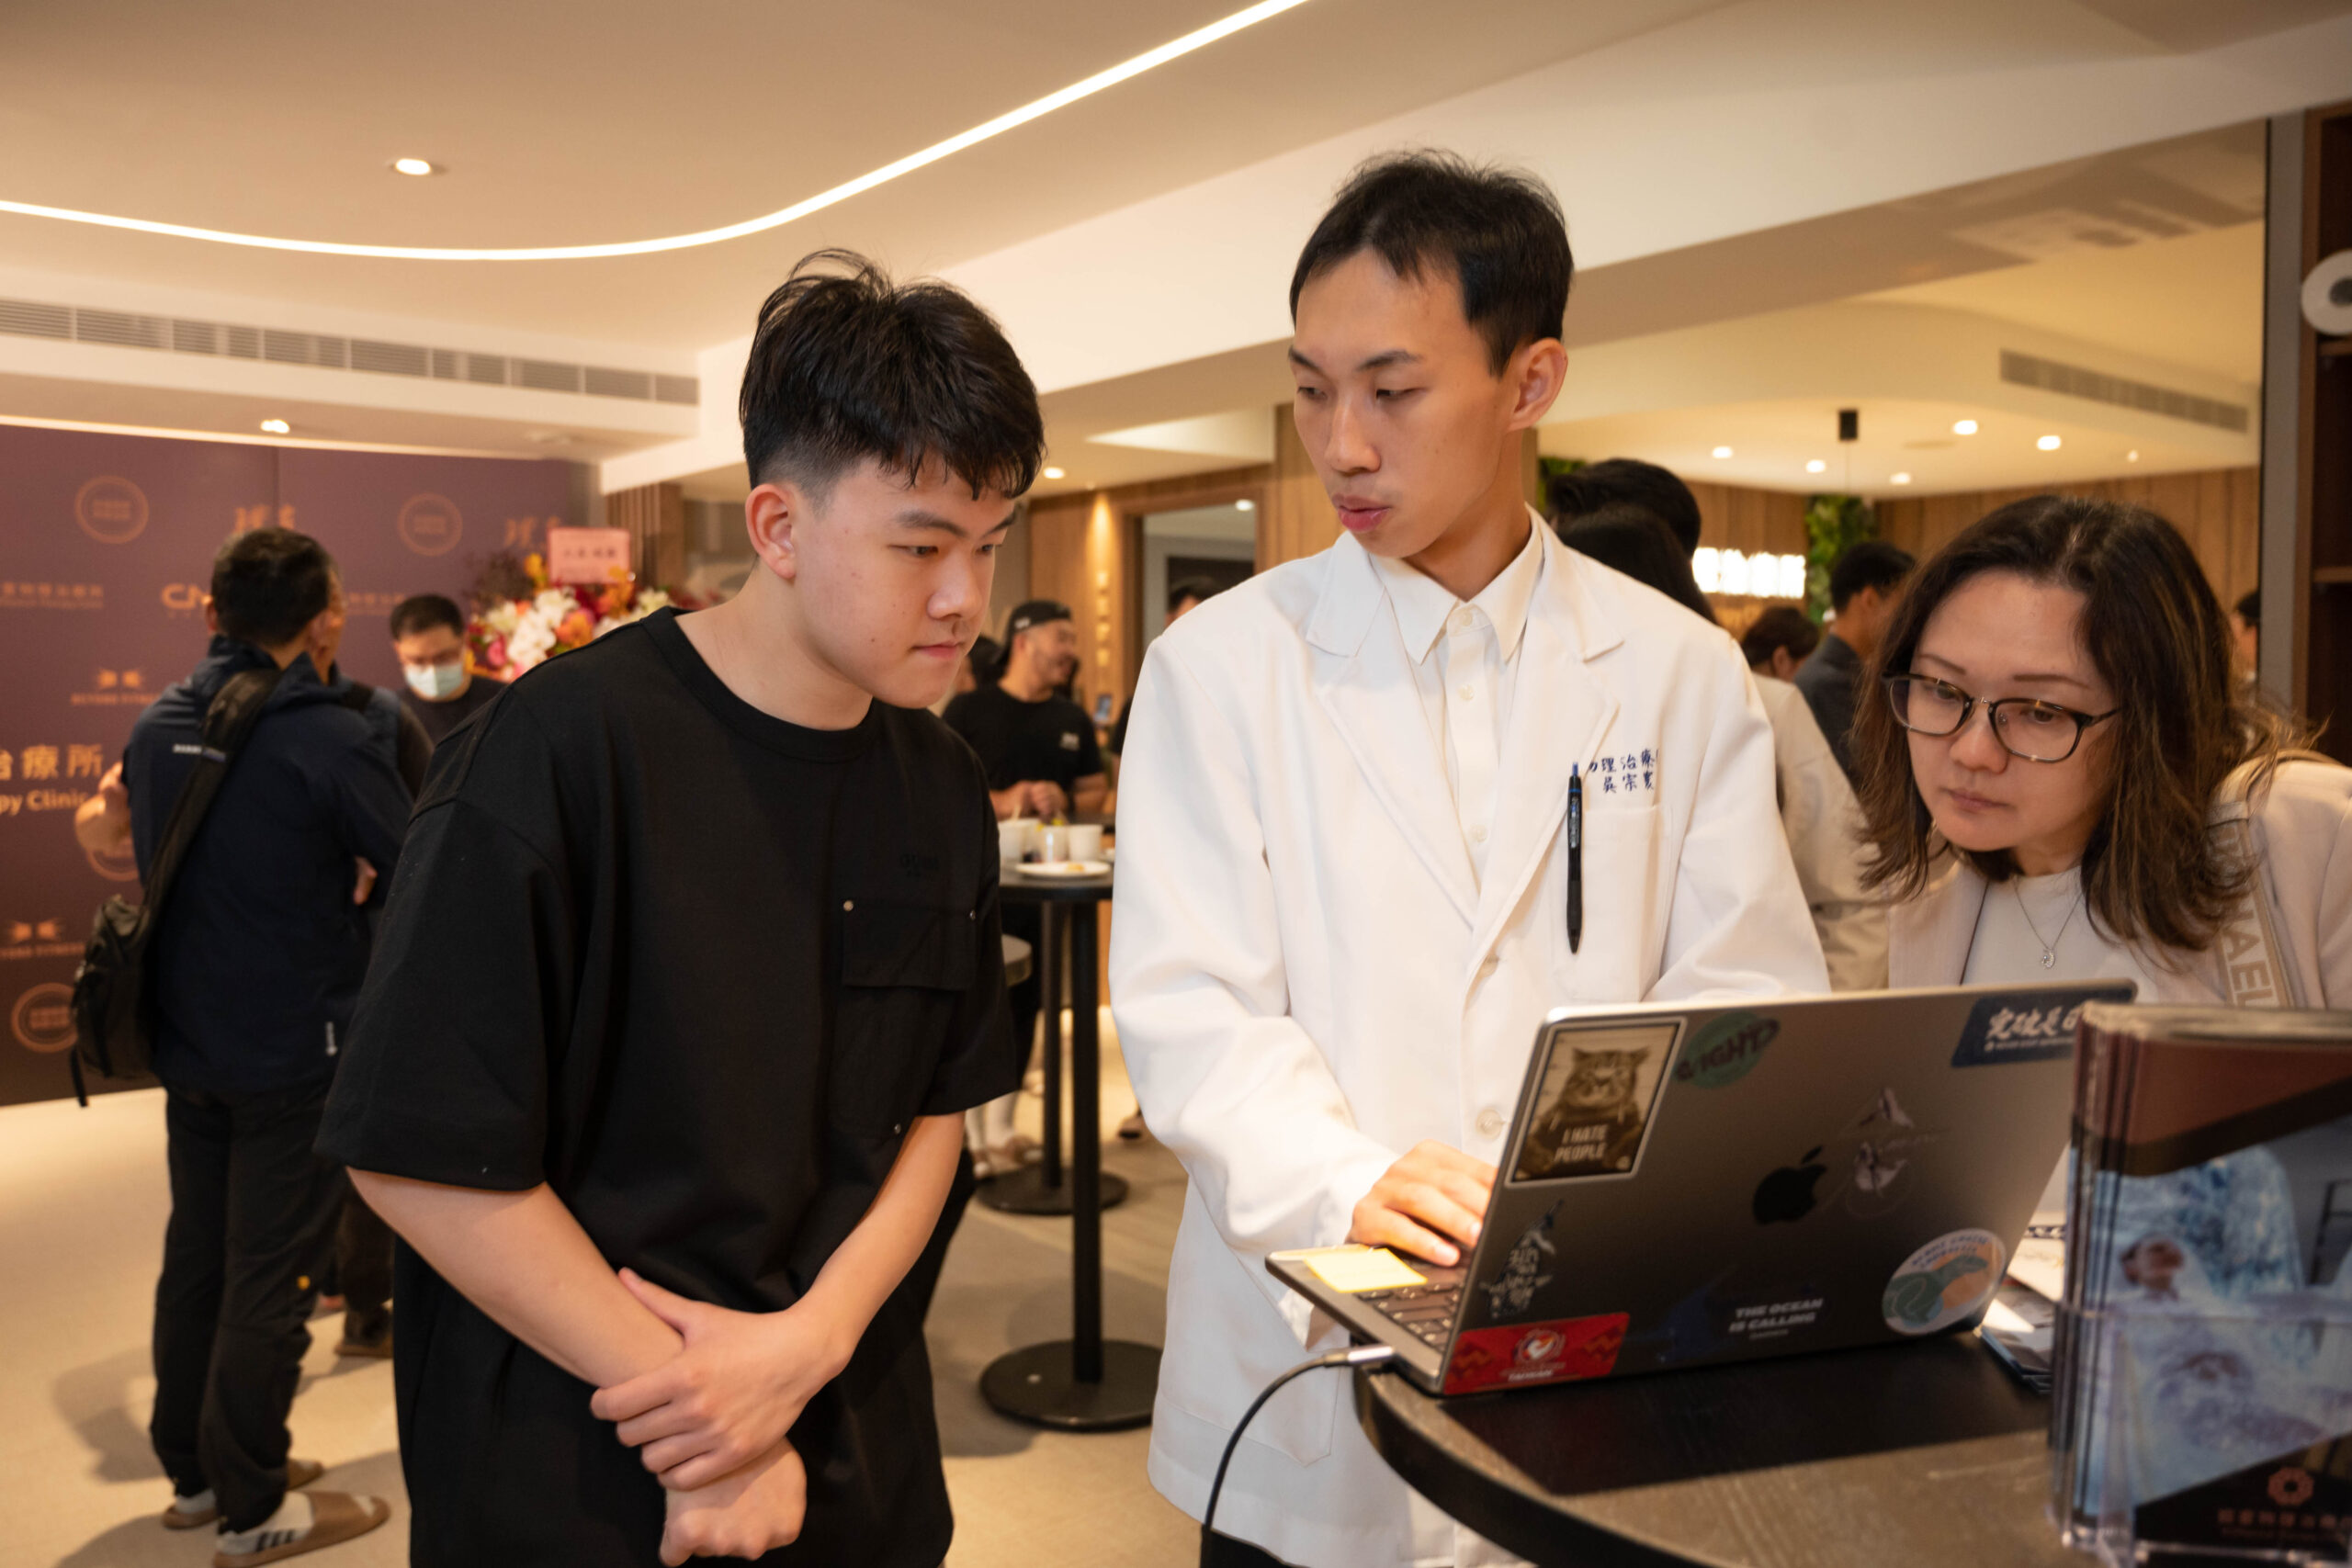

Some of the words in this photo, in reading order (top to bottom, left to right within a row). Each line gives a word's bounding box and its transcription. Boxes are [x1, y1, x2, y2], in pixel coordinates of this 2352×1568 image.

[1562, 1128, 1570, 1145] I
[1571, 1123, 1608, 1143] HATE
[1555, 1142, 1608, 1164] PEOPLE
[1736, 1304, 1768, 1318] THE
[1769, 1298, 1823, 1314] OCEAN
[1728, 1321, 1746, 1333] IS
[1747, 1312, 1816, 1330] CALLING
